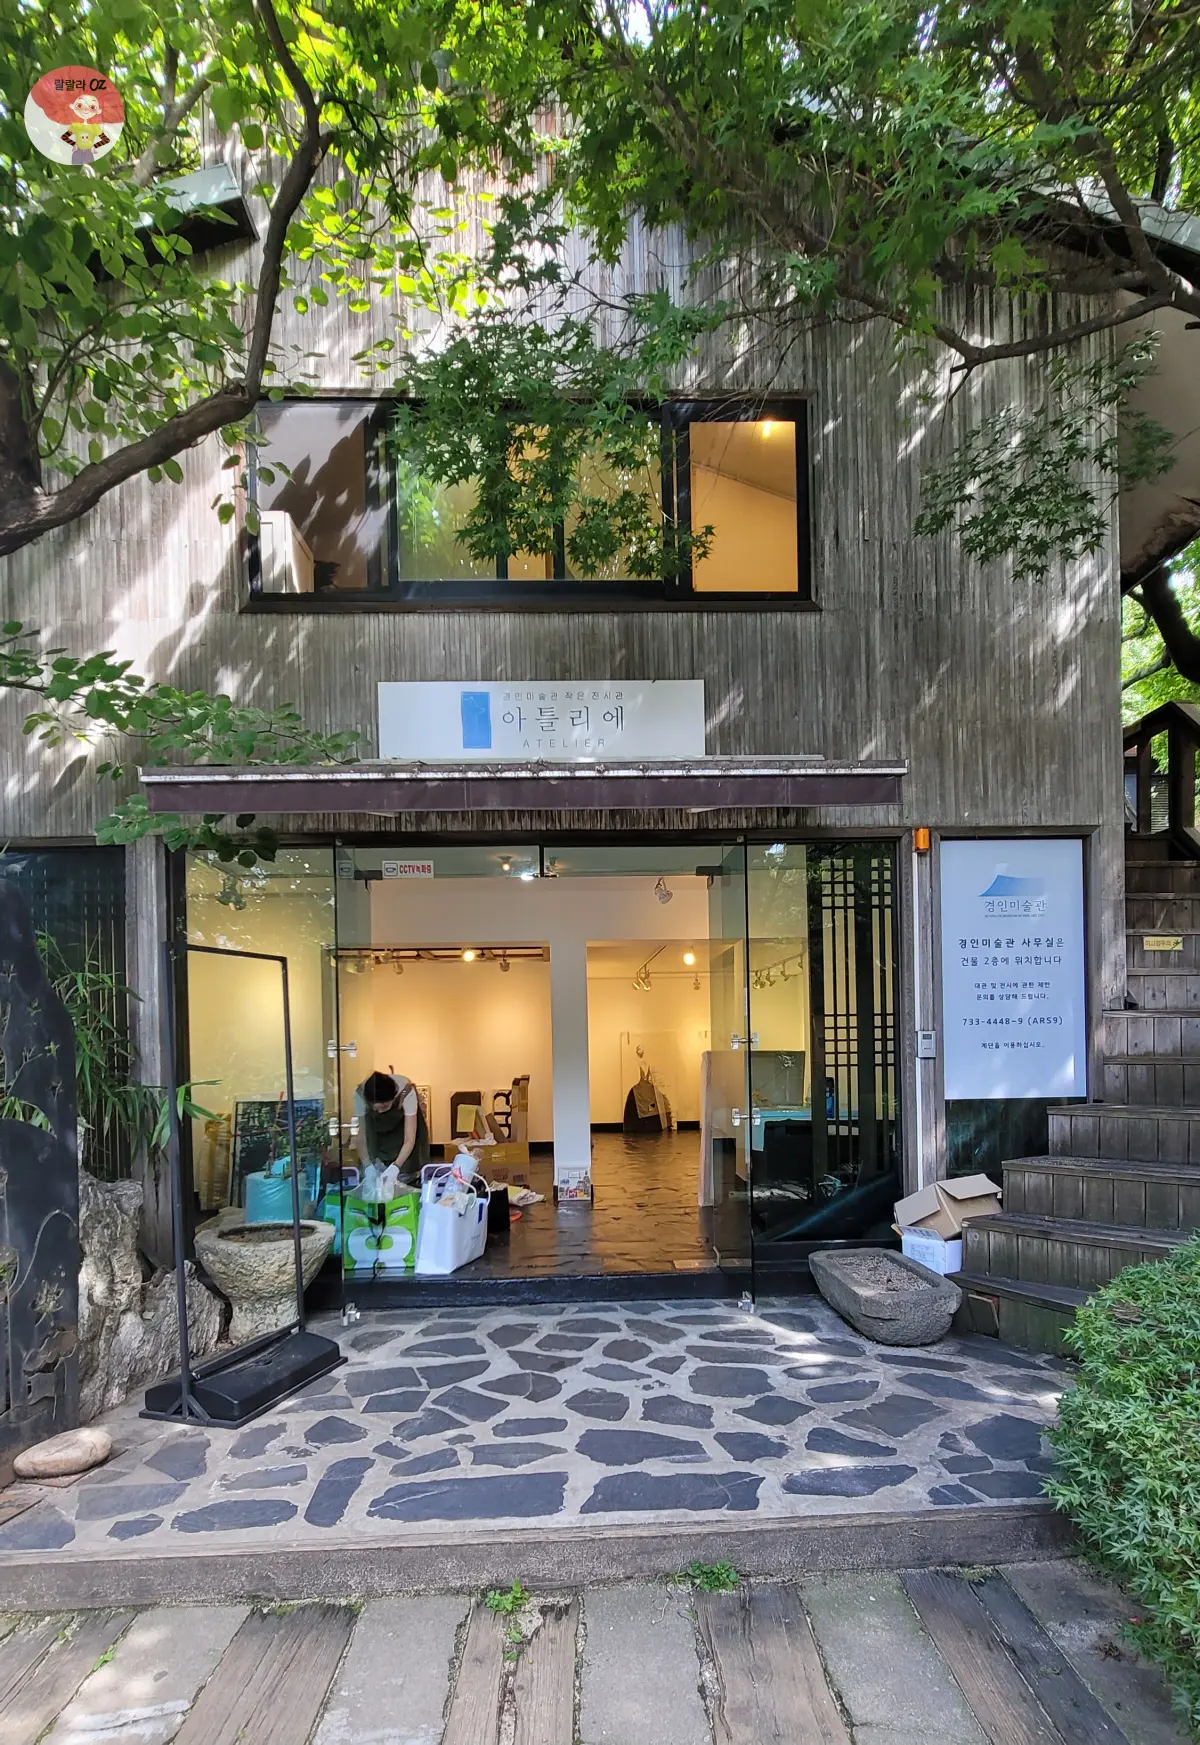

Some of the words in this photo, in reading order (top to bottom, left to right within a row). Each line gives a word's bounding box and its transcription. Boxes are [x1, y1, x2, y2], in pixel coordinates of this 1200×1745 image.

[565, 691, 585, 700] 작은
[592, 691, 624, 700] 전시관
[502, 705, 625, 733] 아틀리에
[523, 739, 606, 748] ATELIER
[985, 900, 1047, 913] 경인미술관
[958, 938, 1015, 949] 경인미술관
[1021, 937, 1065, 948] 사무실은
[961, 957, 979, 967] 건물
[984, 957, 1010, 967] 2층에
[1014, 955, 1062, 966] 위치합니다
[974, 982, 987, 990] 대관
[976, 993, 995, 1001] 문의를
[998, 993, 1018, 1001] 상담해
[1021, 992, 1049, 1000] 드립니다.
[1027, 1016, 1063, 1027] (ARS9)
[981, 1042, 1000, 1050] 계단을
